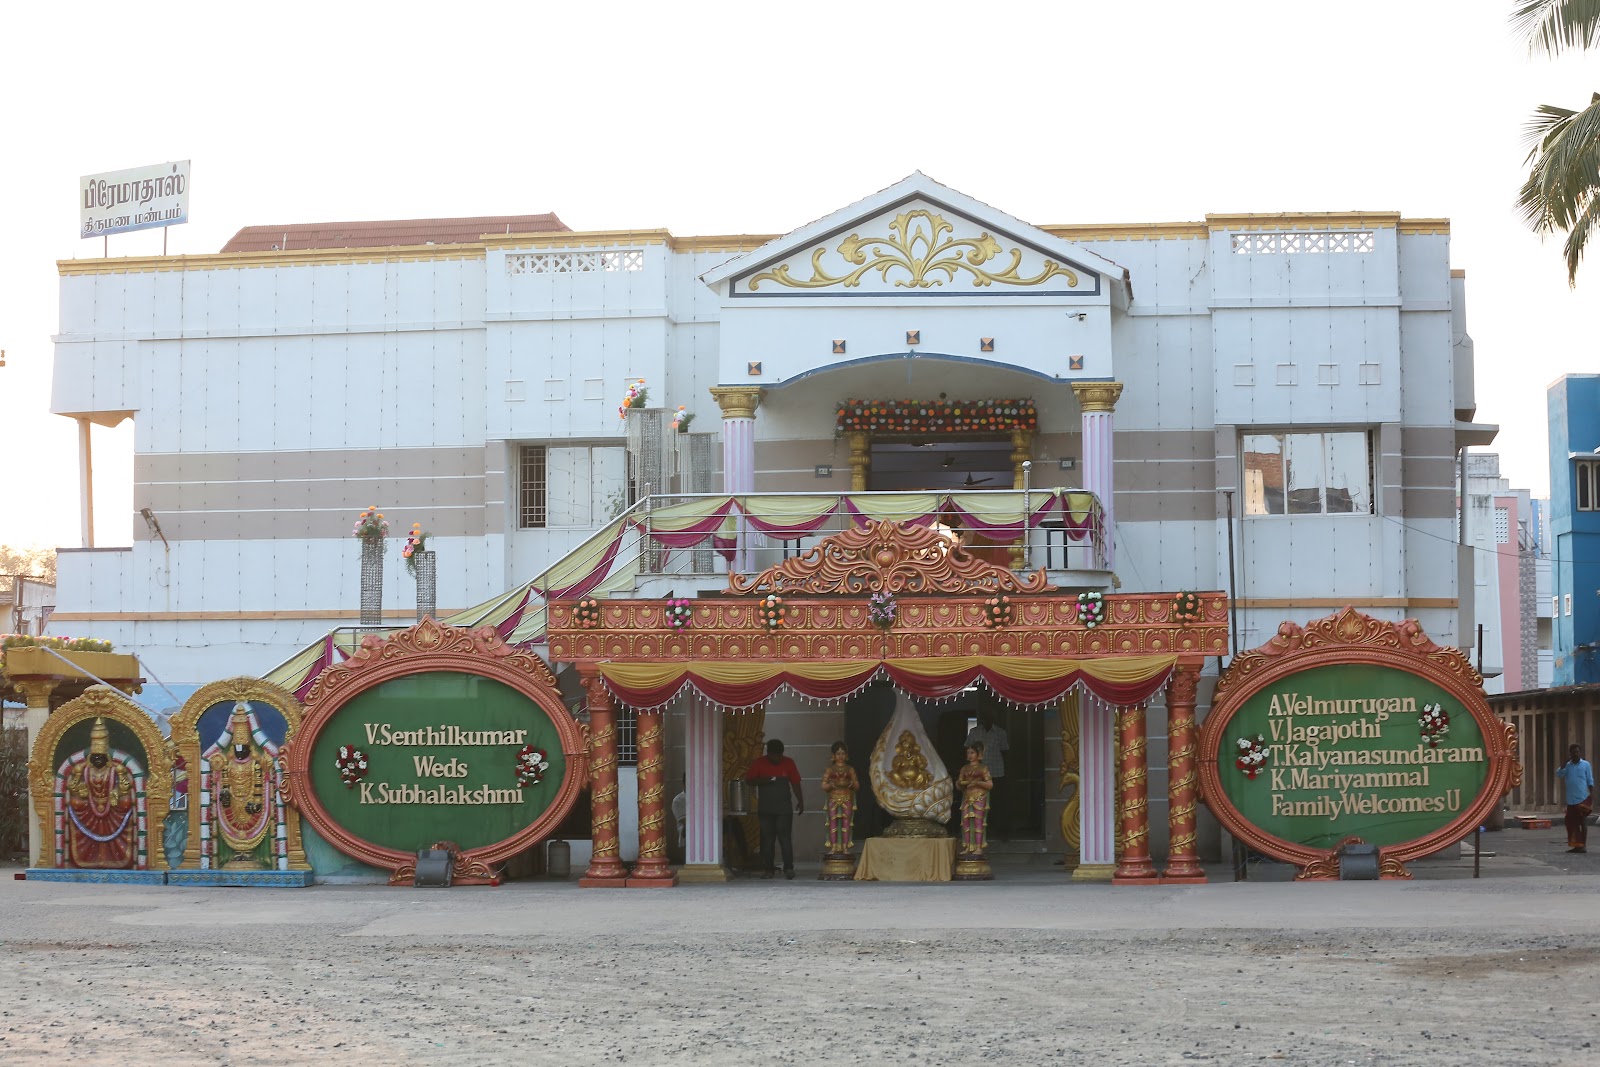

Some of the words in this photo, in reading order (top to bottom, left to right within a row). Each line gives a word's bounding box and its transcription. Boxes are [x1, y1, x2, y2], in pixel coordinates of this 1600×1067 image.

[134, 202, 182, 225] மண்டபம்
[1267, 692, 1417, 721] A.Velmurugan
[363, 722, 528, 746] V.Senthilkumar
[1268, 716, 1382, 746] V.Jagajothi
[412, 755, 469, 779] Weds
[1268, 743, 1484, 771] T.Kalyanasundaram
[1270, 765, 1430, 794] K.Mariyammal
[359, 782, 525, 805] K.Subhalakshmi
